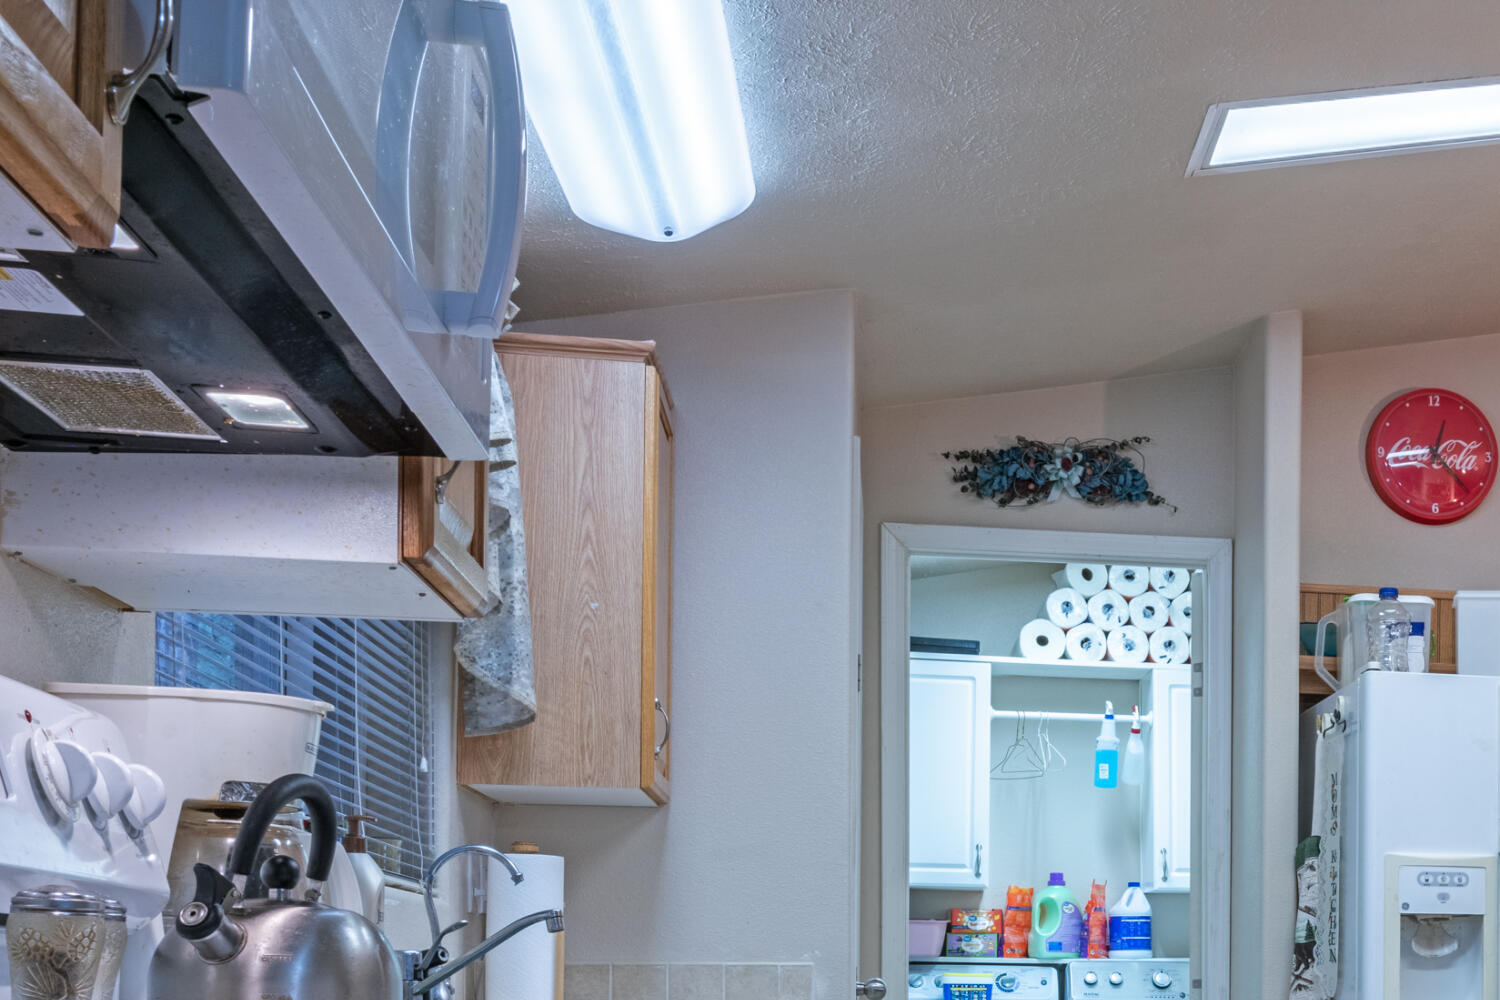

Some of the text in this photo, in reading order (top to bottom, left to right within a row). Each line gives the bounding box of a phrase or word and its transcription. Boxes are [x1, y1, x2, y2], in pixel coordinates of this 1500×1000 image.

[1428, 395, 1440, 407] 12
[1377, 437, 1492, 471] 9 CocaCola 3
[1431, 502, 1439, 514] 6
